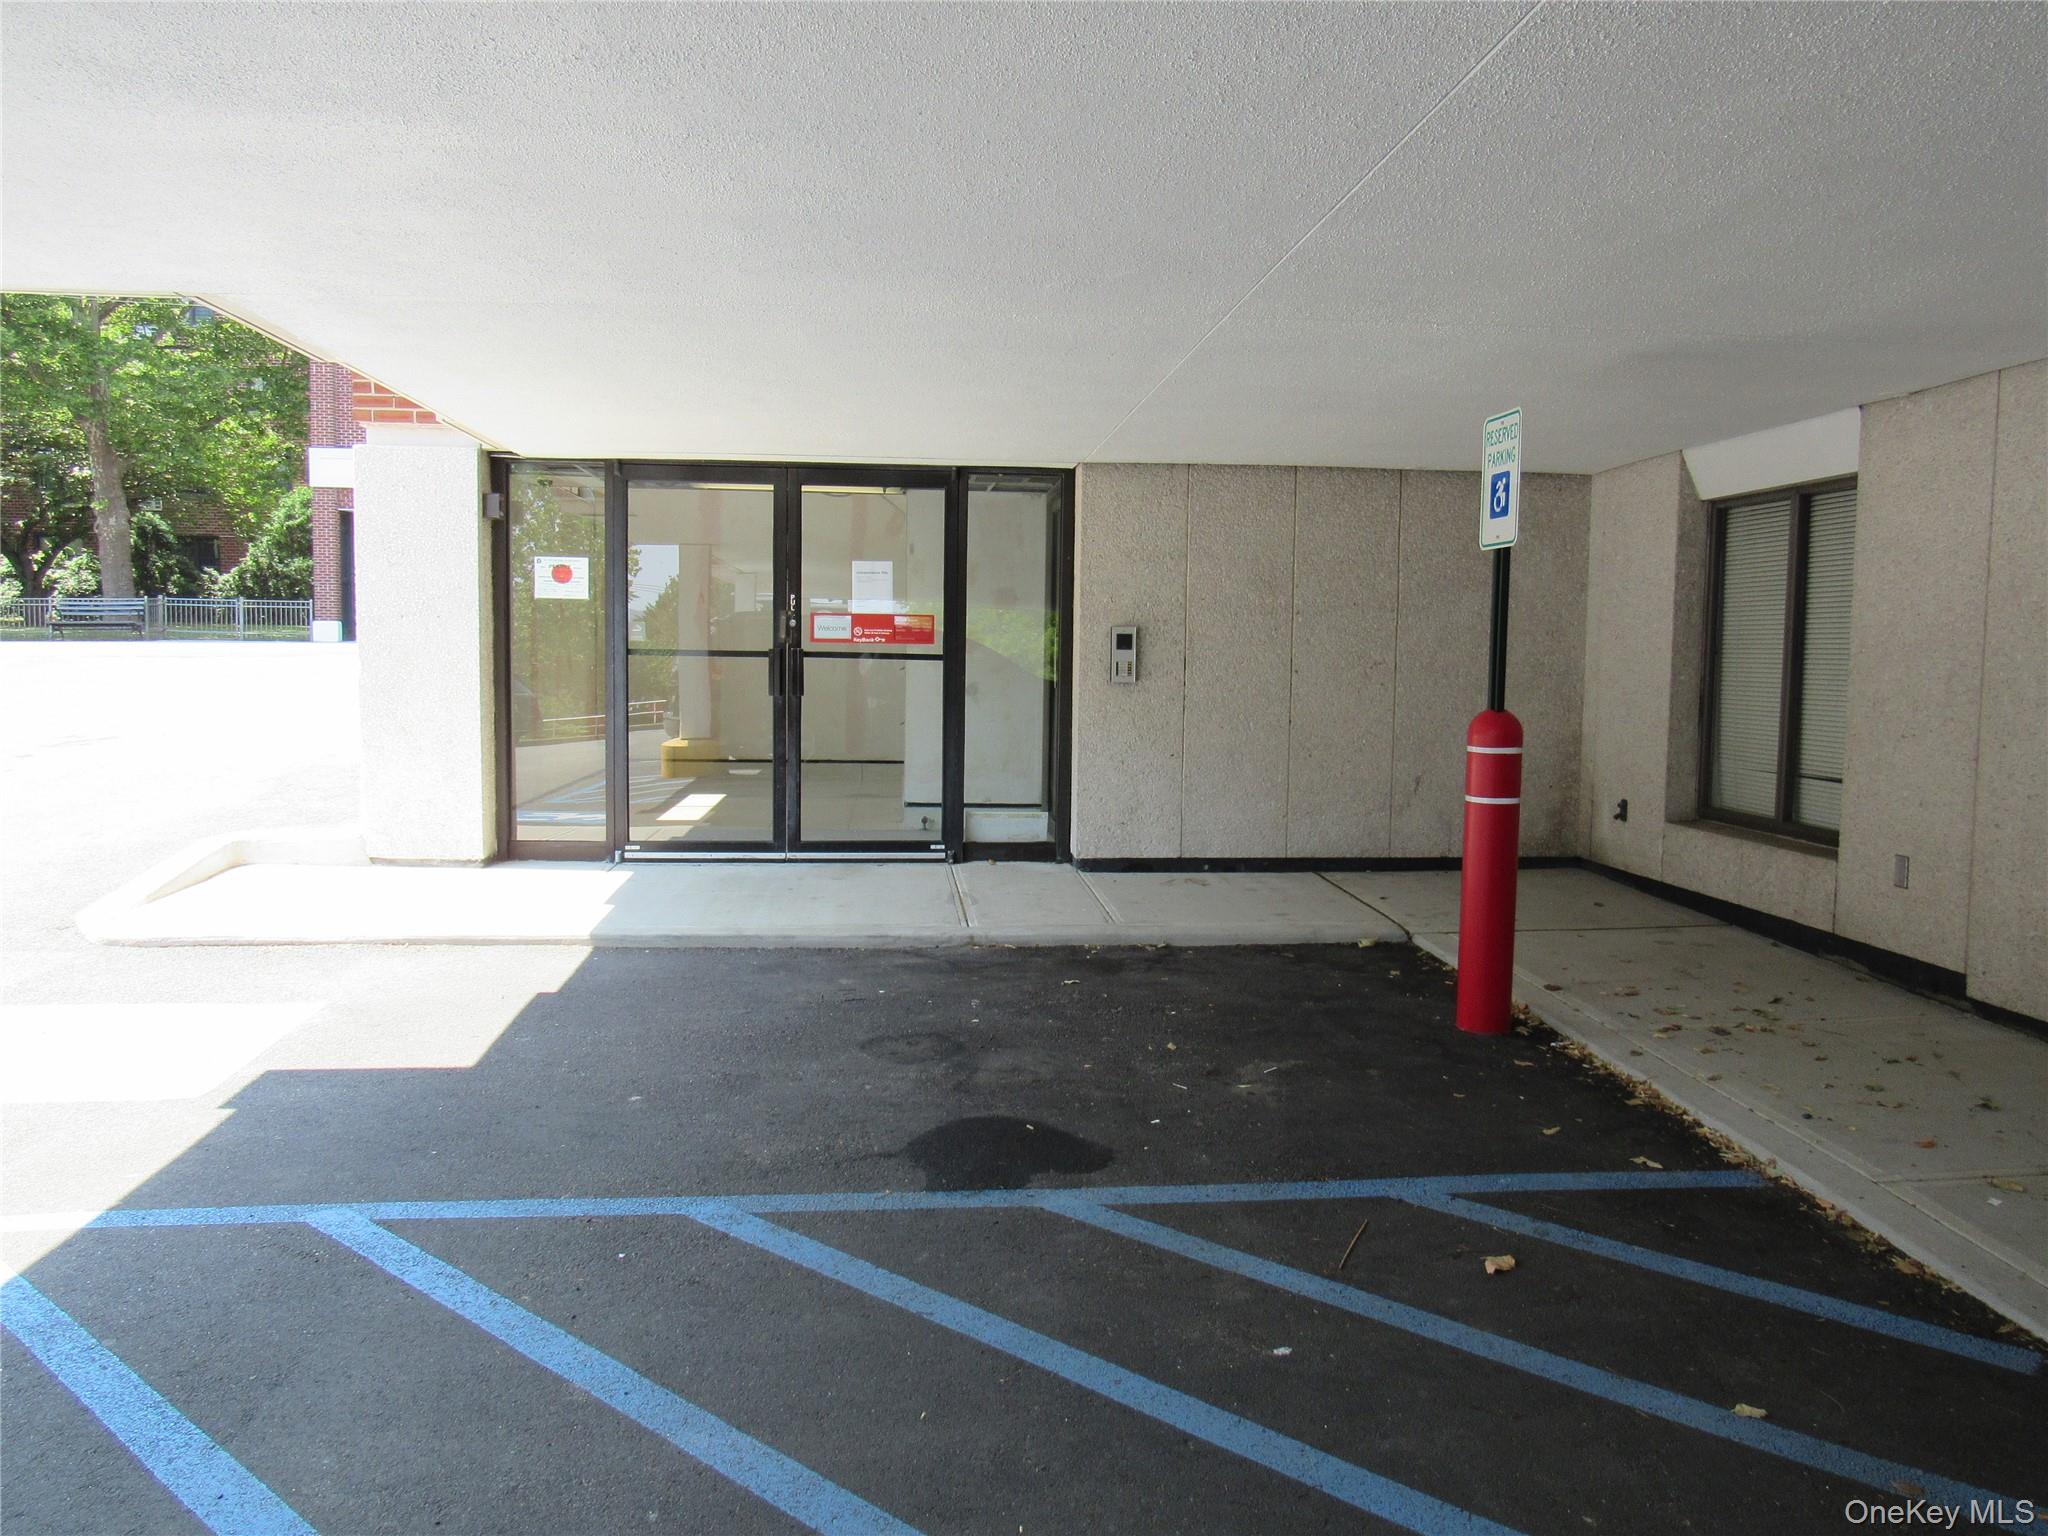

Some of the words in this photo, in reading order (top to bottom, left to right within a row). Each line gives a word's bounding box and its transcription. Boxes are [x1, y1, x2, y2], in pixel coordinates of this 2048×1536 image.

[1487, 423, 1518, 446] RESERVED
[1487, 446, 1516, 469] PARKING
[816, 624, 848, 632] Welcome
